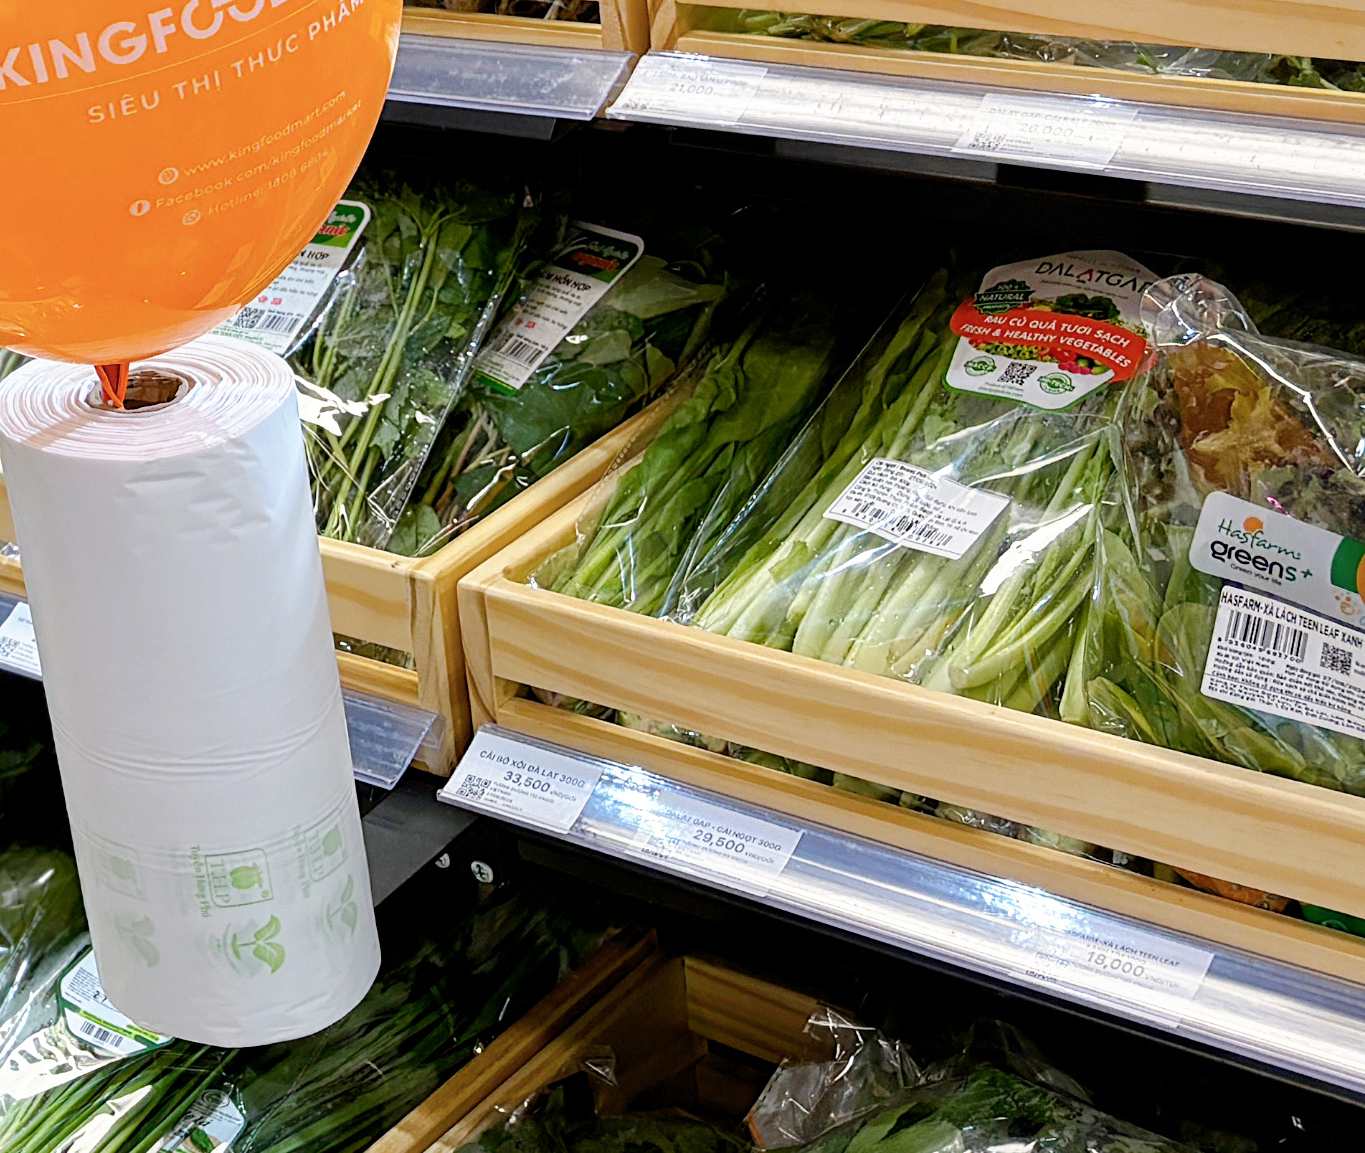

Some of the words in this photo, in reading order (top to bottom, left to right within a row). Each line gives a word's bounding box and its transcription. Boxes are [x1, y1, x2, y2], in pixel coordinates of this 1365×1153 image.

[88, 91, 161, 124] SIÊU
[172, 70, 223, 102] THỊ
[669, 83, 714, 96] 21,000
[183, 90, 346, 177] www.kingfoodmart.com
[1018, 122, 1074, 137] 26,000
[979, 292, 1025, 302] NATURAL
[960, 323, 990, 336] FRESH
[992, 328, 1002, 338] &
[1004, 329, 1057, 344] HEALTHY
[1059, 335, 1132, 369] VEGETABLES
[1094, 329, 1131, 348] SẠCH
[1218, 518, 1298, 560] Hasfarm
[1298, 615, 1319, 632] TEEN
[1320, 622, 1340, 639] LEAF
[1341, 631, 1363, 649] XANH
[479, 750, 496, 762] CẢI
[510, 759, 526, 771] XÔI
[527, 765, 541, 775] ĐÀ
[559, 774, 586, 789] 300G
[503, 770, 551, 793] 33,500
[693, 829, 747, 854] 29,500
[758, 837, 782, 852] 300G
[1086, 950, 1145, 978] 18,000
